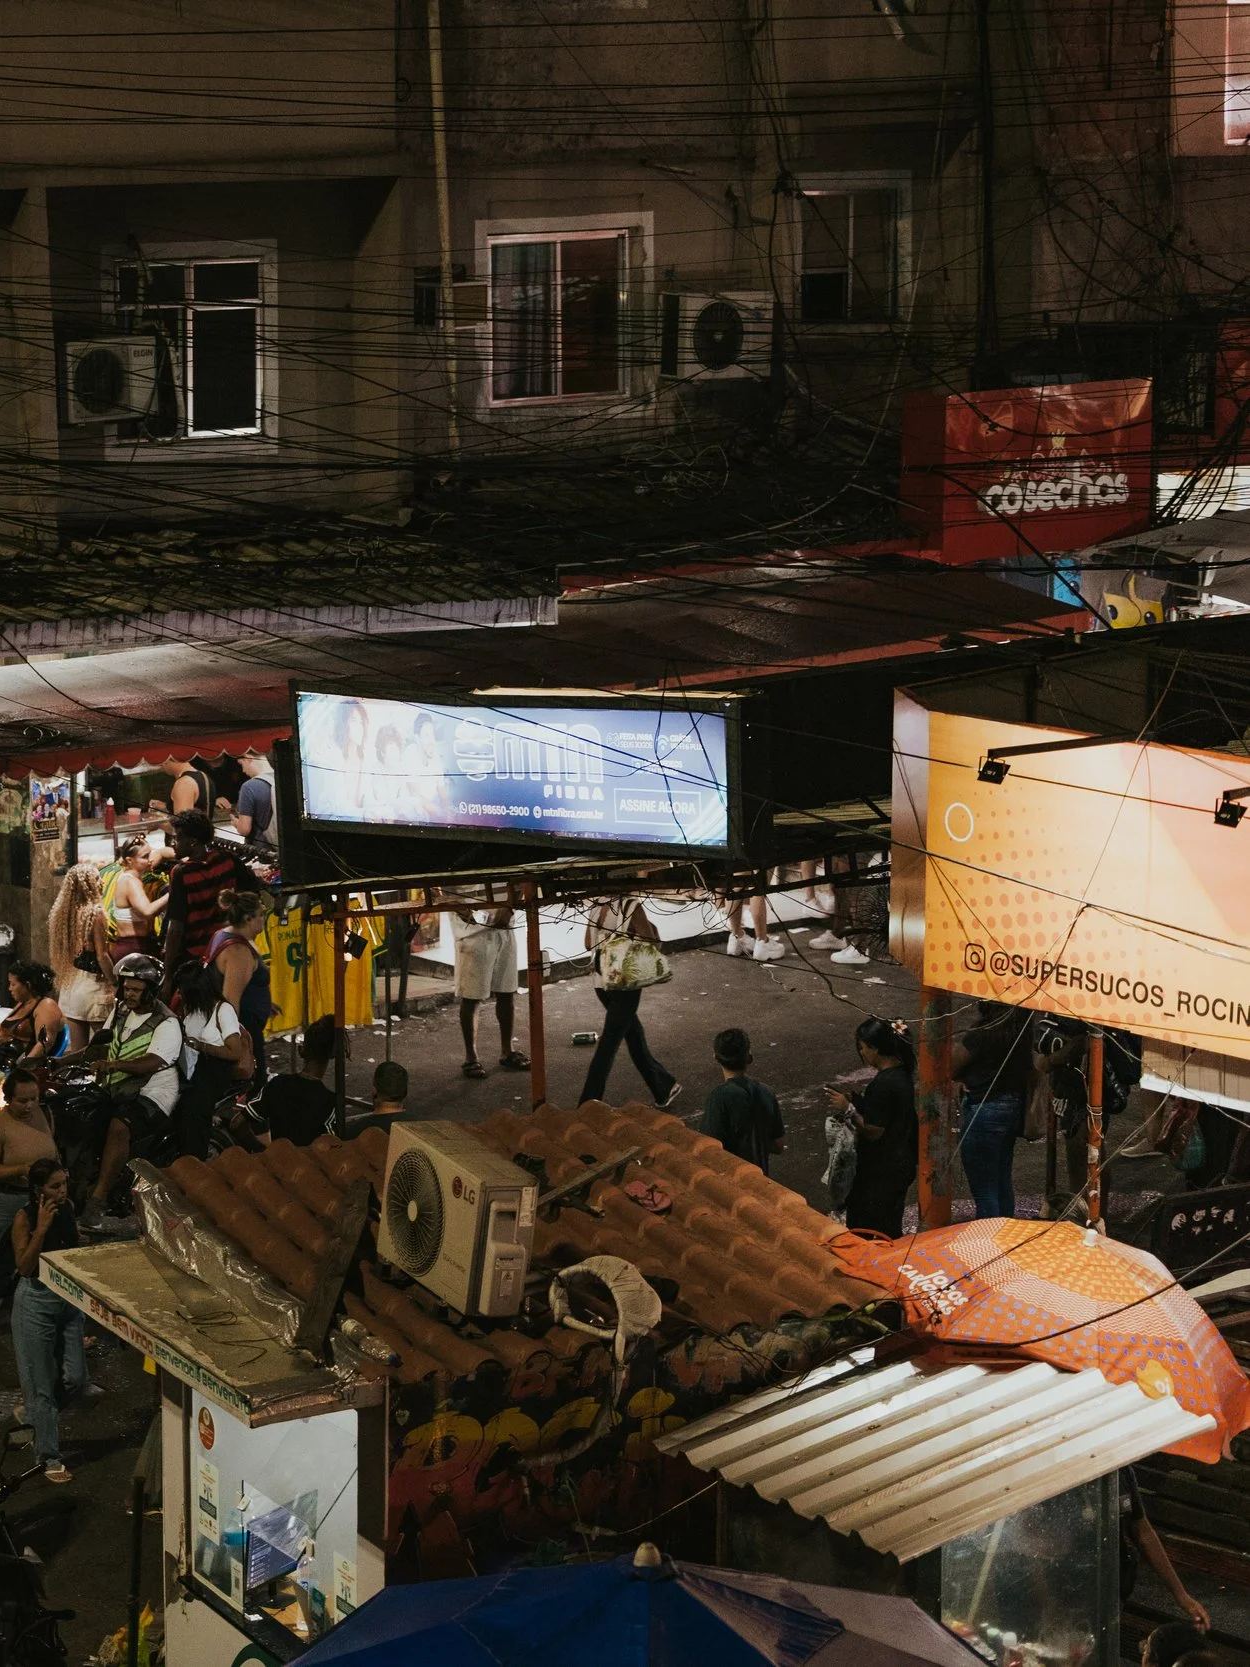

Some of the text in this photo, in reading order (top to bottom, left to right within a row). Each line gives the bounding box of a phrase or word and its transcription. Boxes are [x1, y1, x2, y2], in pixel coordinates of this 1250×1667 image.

[133, 349, 153, 358] ELGIN
[983, 461, 1130, 516] cosechas
[543, 784, 604, 801] FIBRA
[468, 803, 482, 816] (21)
[619, 798, 696, 815] ASSINE AGORA
[463, 1185, 476, 1205] LG
